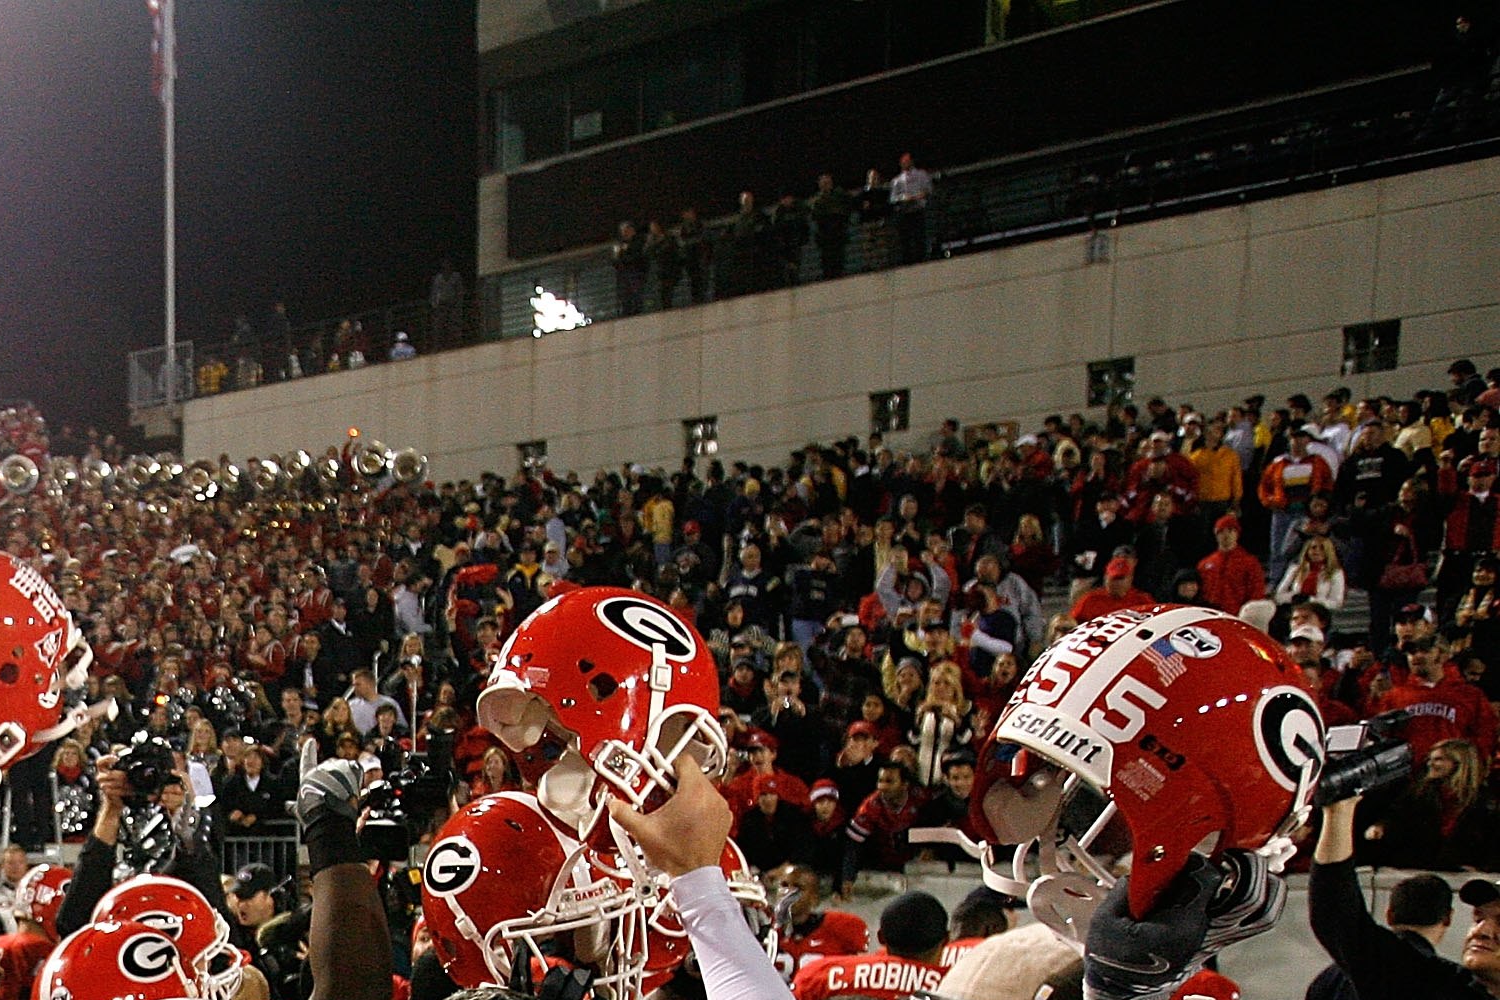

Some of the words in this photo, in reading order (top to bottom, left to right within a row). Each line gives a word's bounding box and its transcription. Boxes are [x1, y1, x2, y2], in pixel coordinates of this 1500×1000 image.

[1012, 713, 1102, 764] schutt
[828, 966, 849, 991] C.
[854, 961, 941, 993] ROBINS
